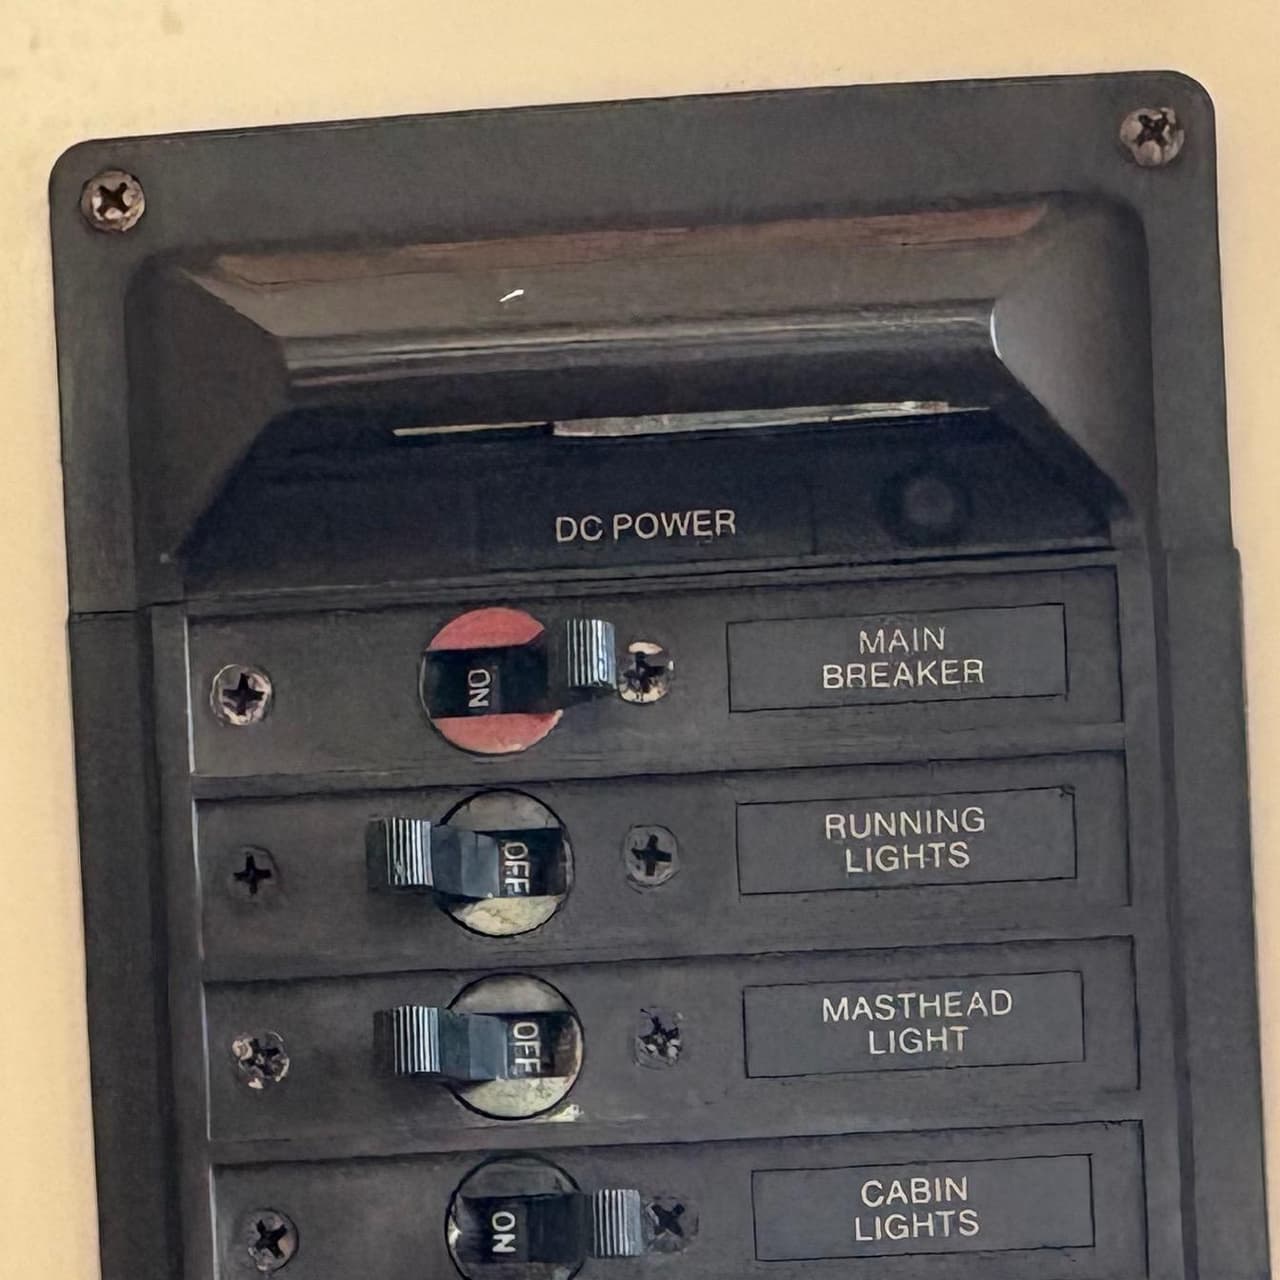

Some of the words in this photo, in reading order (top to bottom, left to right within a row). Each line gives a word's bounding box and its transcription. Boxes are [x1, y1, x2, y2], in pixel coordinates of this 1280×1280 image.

[555, 515, 603, 543] DC
[613, 509, 736, 540] POWER
[859, 627, 945, 654] MAIN
[468, 668, 491, 708] ON
[822, 659, 984, 689] BREAKER
[825, 806, 985, 841] RUNNING
[504, 842, 530, 893] OFF
[845, 841, 970, 873] LIGHTS
[822, 989, 1012, 1023] MASTHEAD
[512, 1022, 541, 1075] OFF
[868, 1025, 969, 1055] LIGHT
[861, 1176, 968, 1208] CABIN
[492, 1211, 516, 1253] ON
[855, 1209, 980, 1241] LIGHTS
